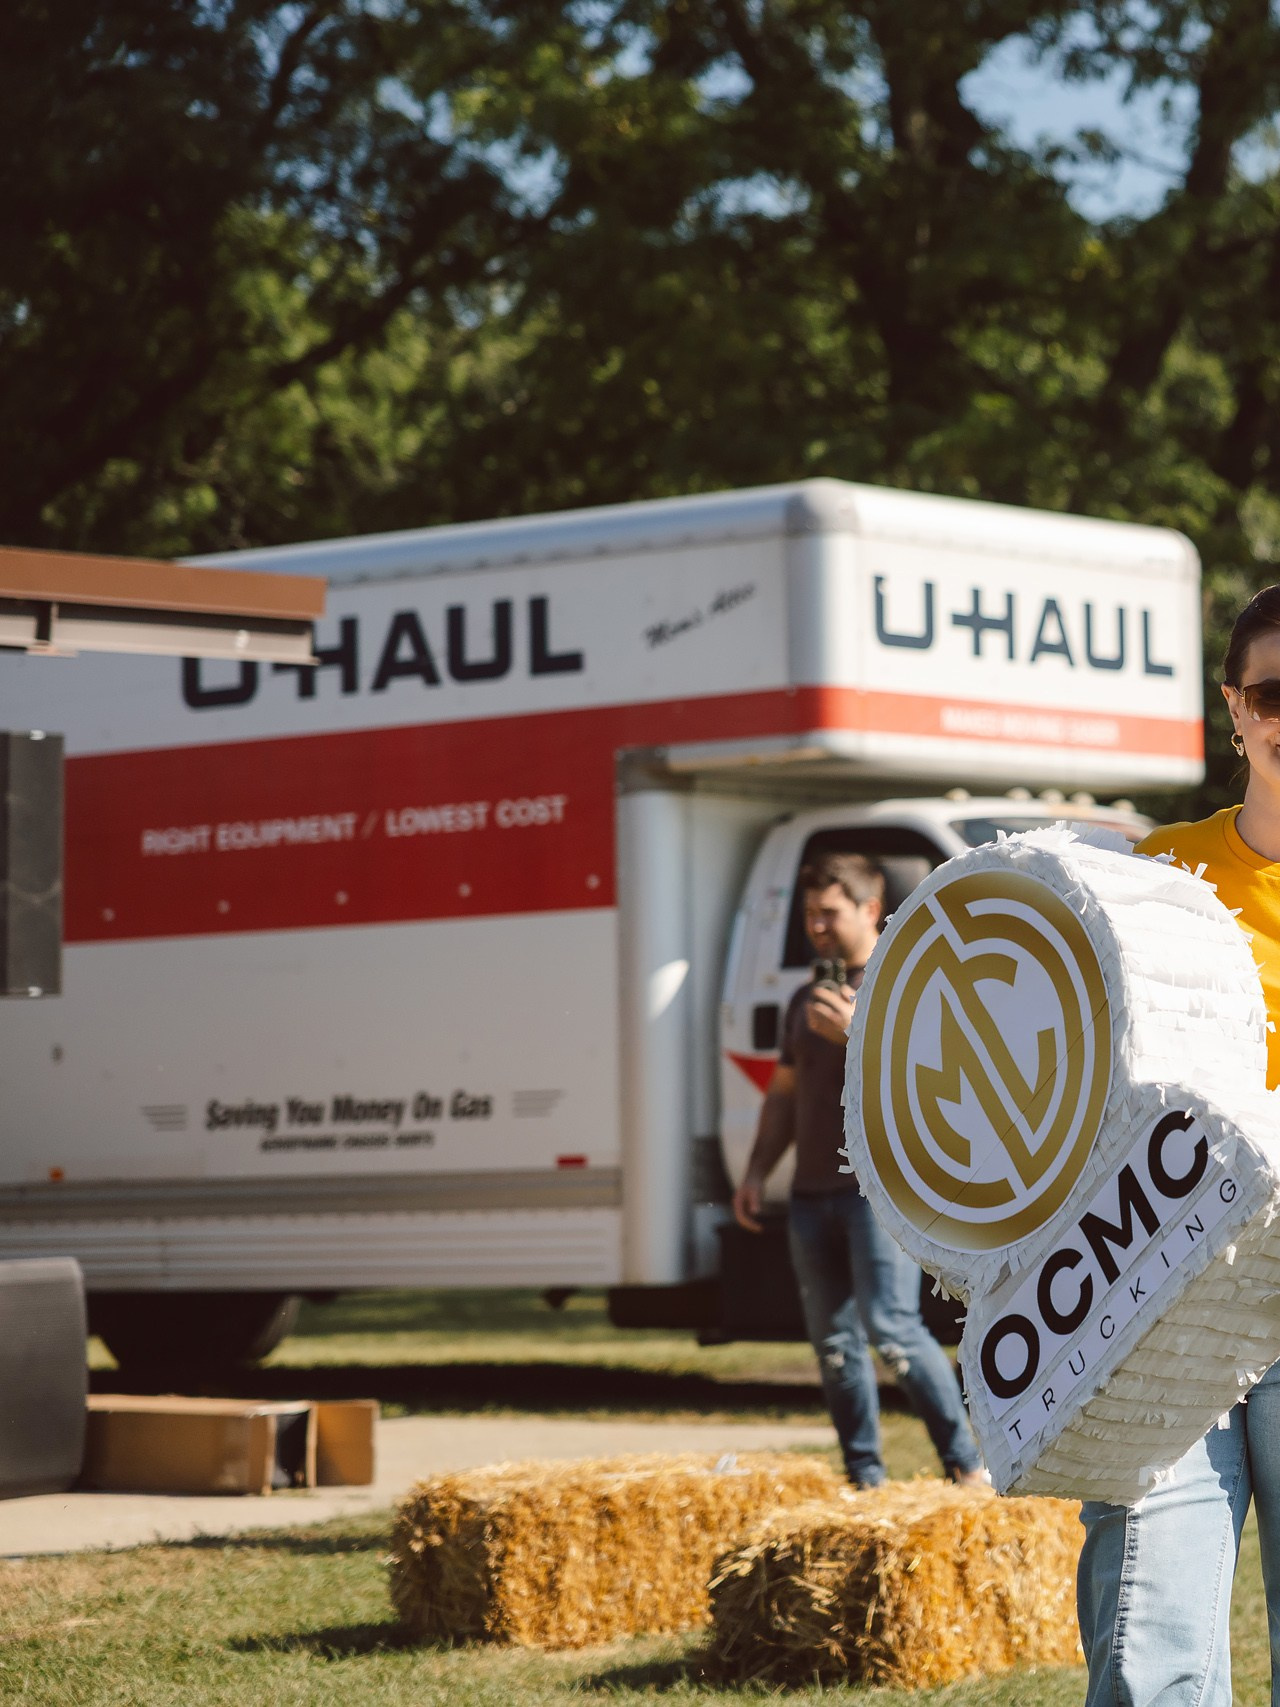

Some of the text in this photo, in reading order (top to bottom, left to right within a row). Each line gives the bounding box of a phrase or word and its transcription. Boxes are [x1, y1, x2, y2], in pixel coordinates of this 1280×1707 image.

[873, 574, 1174, 677] U-HAUL
[141, 824, 210, 855] RIGHT
[215, 812, 357, 851] EQUIPMENT
[384, 801, 490, 837] LOWEST
[495, 794, 567, 828] COST
[206, 1088, 492, 1132] Saving You Money On Gas
[980, 1109, 1209, 1400] OCMC
[1008, 1178, 1237, 1441] TRUCKING
